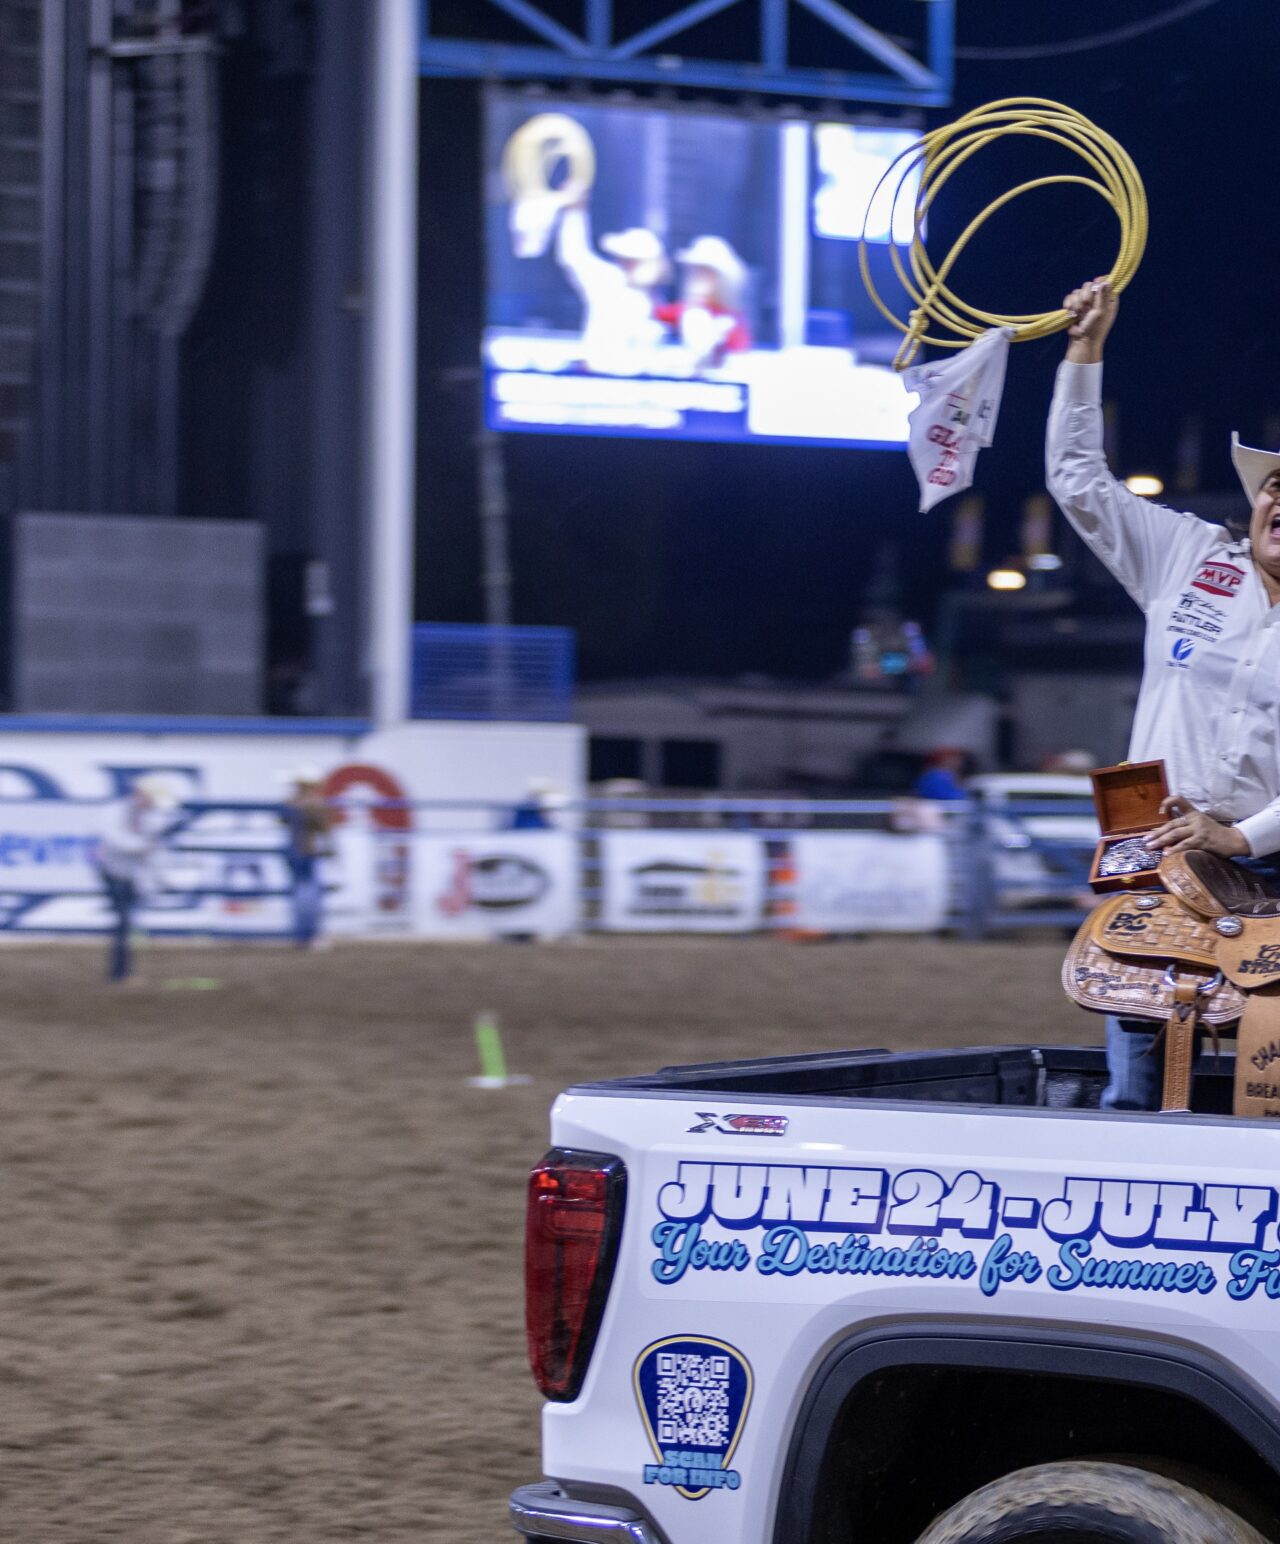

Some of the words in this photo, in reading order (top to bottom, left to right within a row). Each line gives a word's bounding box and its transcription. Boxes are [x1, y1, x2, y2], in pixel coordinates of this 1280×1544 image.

[1196, 568, 1242, 588] MVP
[657, 1160, 890, 1234] JUNE
[651, 1221, 749, 1285] Your
[756, 1225, 977, 1280] Destination
[979, 1233, 1042, 1297] for
[1047, 1238, 1217, 1294] Summer
[663, 1450, 724, 1470] SCAN
[643, 1464, 688, 1485] FOR
[688, 1468, 742, 1490] INFO
